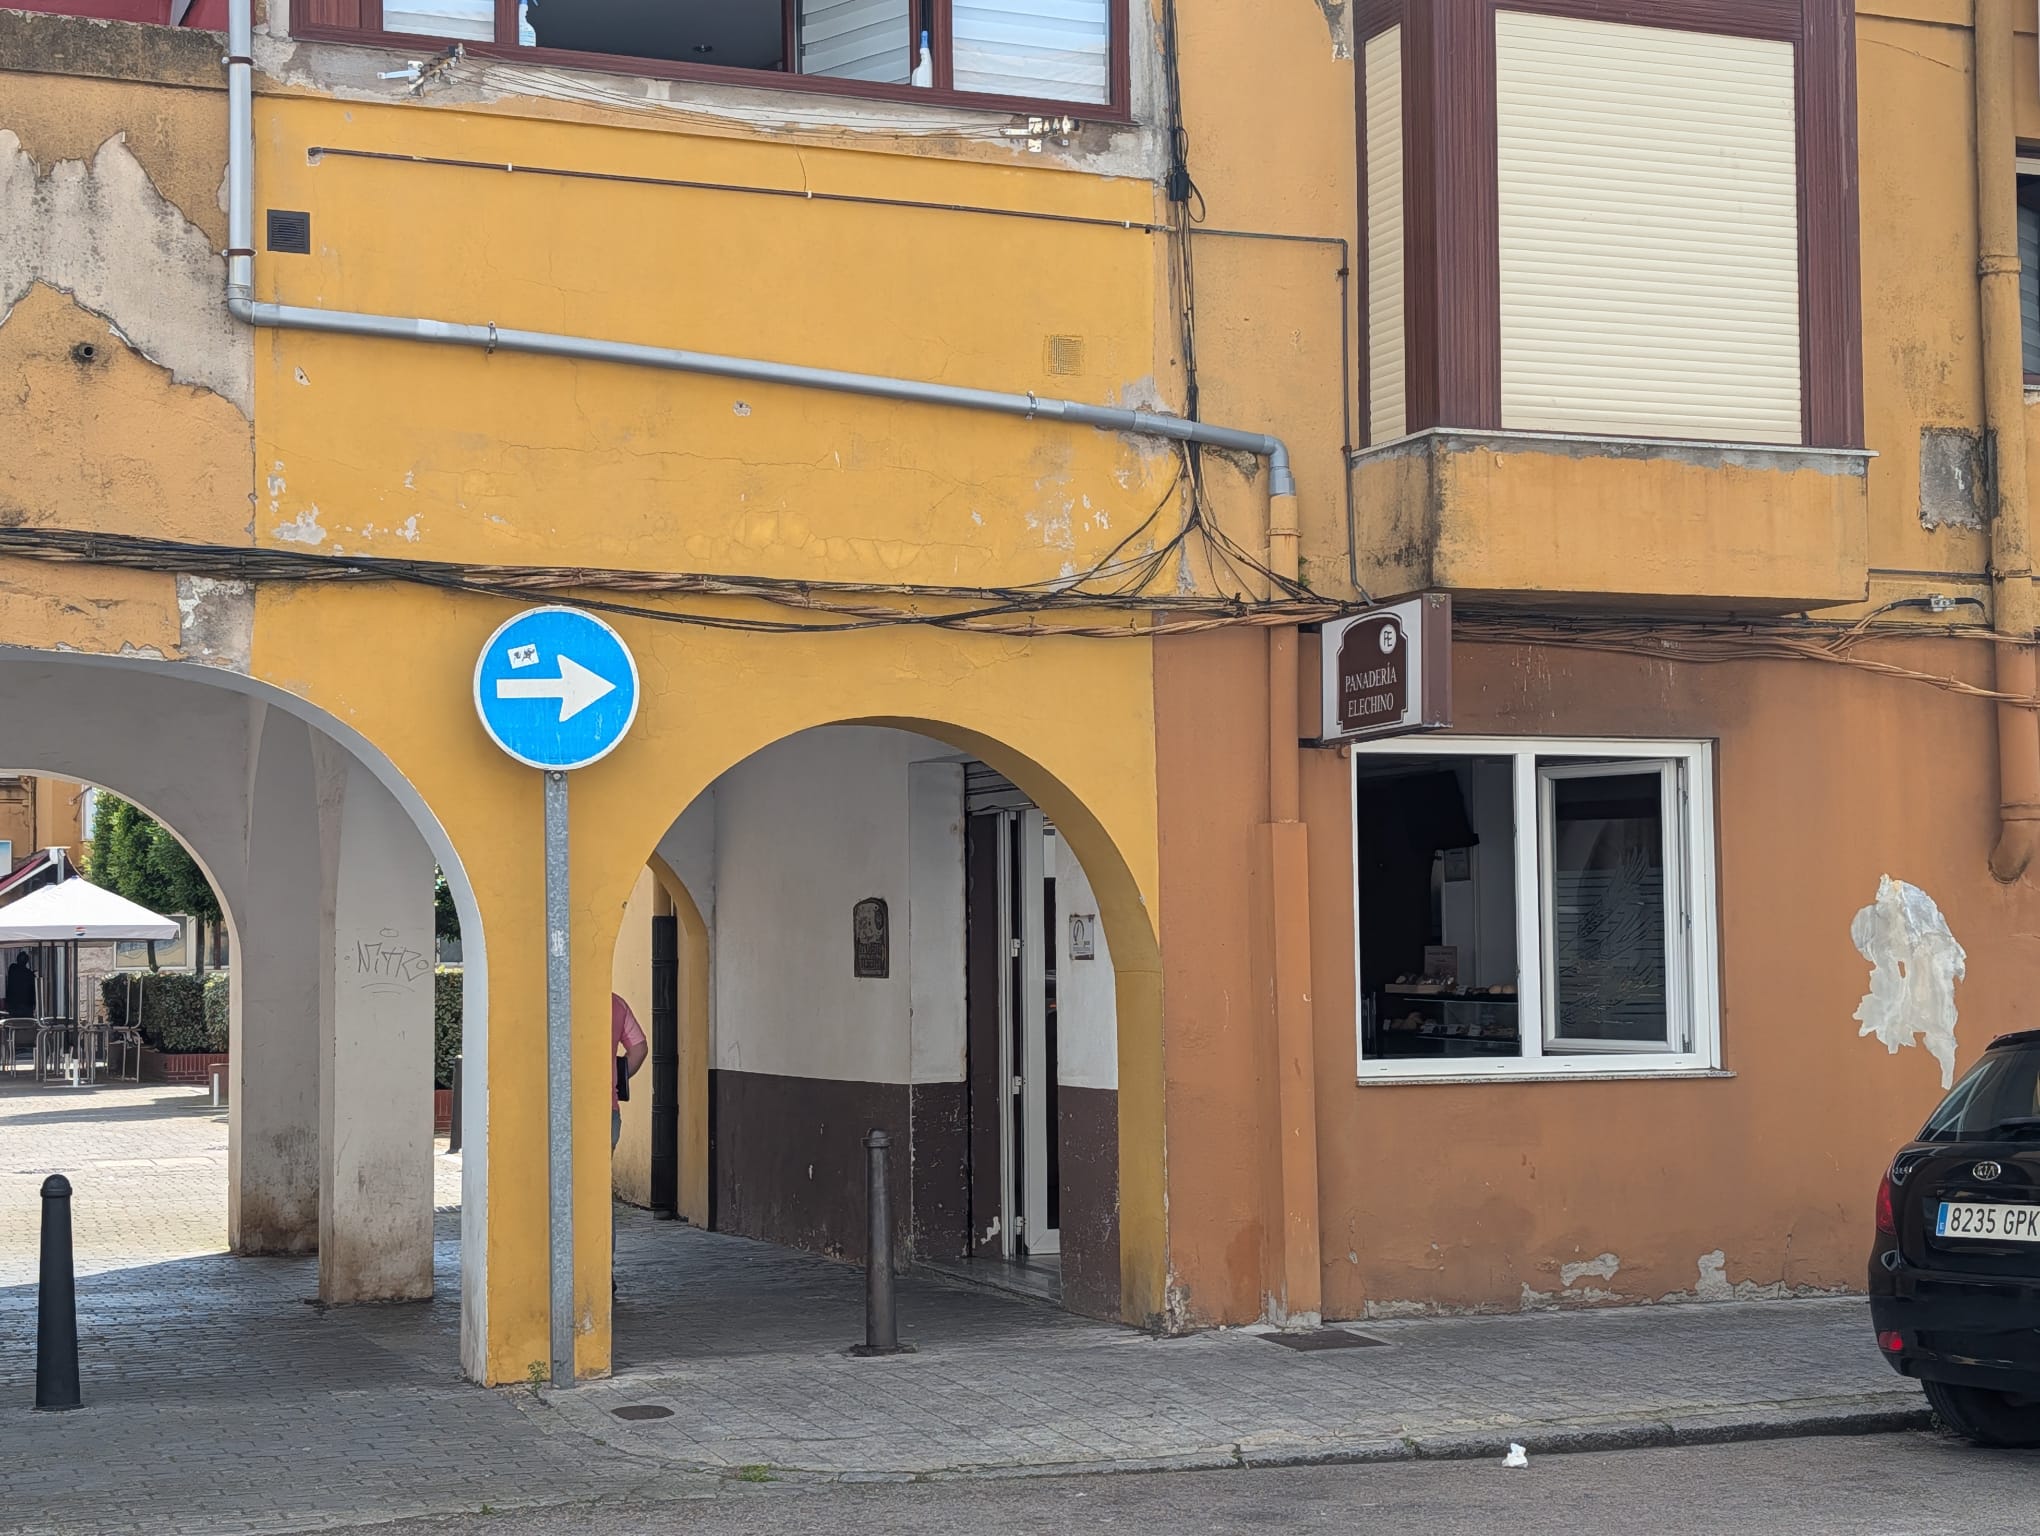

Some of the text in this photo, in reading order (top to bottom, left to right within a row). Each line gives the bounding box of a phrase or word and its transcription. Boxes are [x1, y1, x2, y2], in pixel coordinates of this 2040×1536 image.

[1345, 663, 1397, 693] PANADERÍA
[1348, 693, 1394, 717] ELECHINO
[1950, 1207, 1996, 1234] 8235
[2003, 1209, 2040, 1237] GPK
